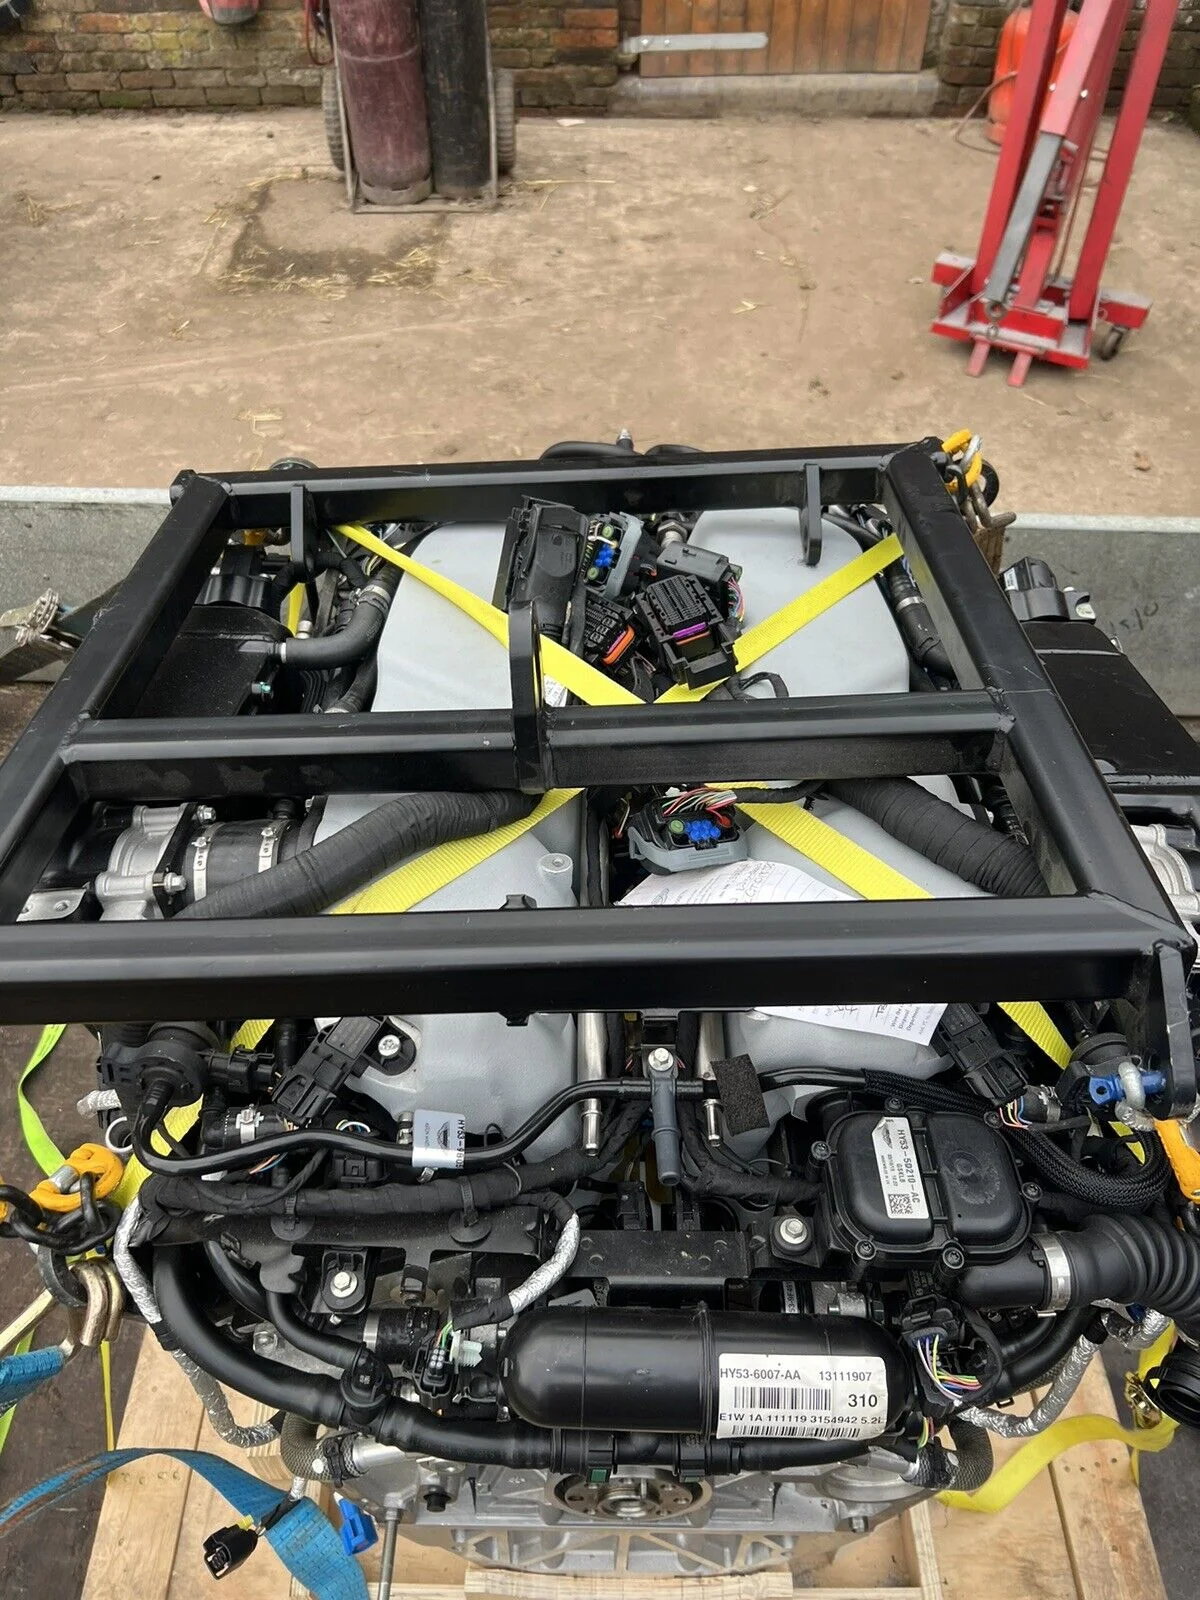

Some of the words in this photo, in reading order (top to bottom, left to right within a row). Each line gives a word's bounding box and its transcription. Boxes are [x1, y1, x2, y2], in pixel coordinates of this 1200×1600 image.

[720, 1368, 801, 1380] HY53-6007-AA
[819, 1370, 872, 1382] 13111907
[848, 1394, 878, 1408] 310
[719, 1413, 745, 1422] E1W
[750, 1413, 763, 1422] 1A
[768, 1414, 807, 1423] 111119
[810, 1415, 858, 1424] 3154942
